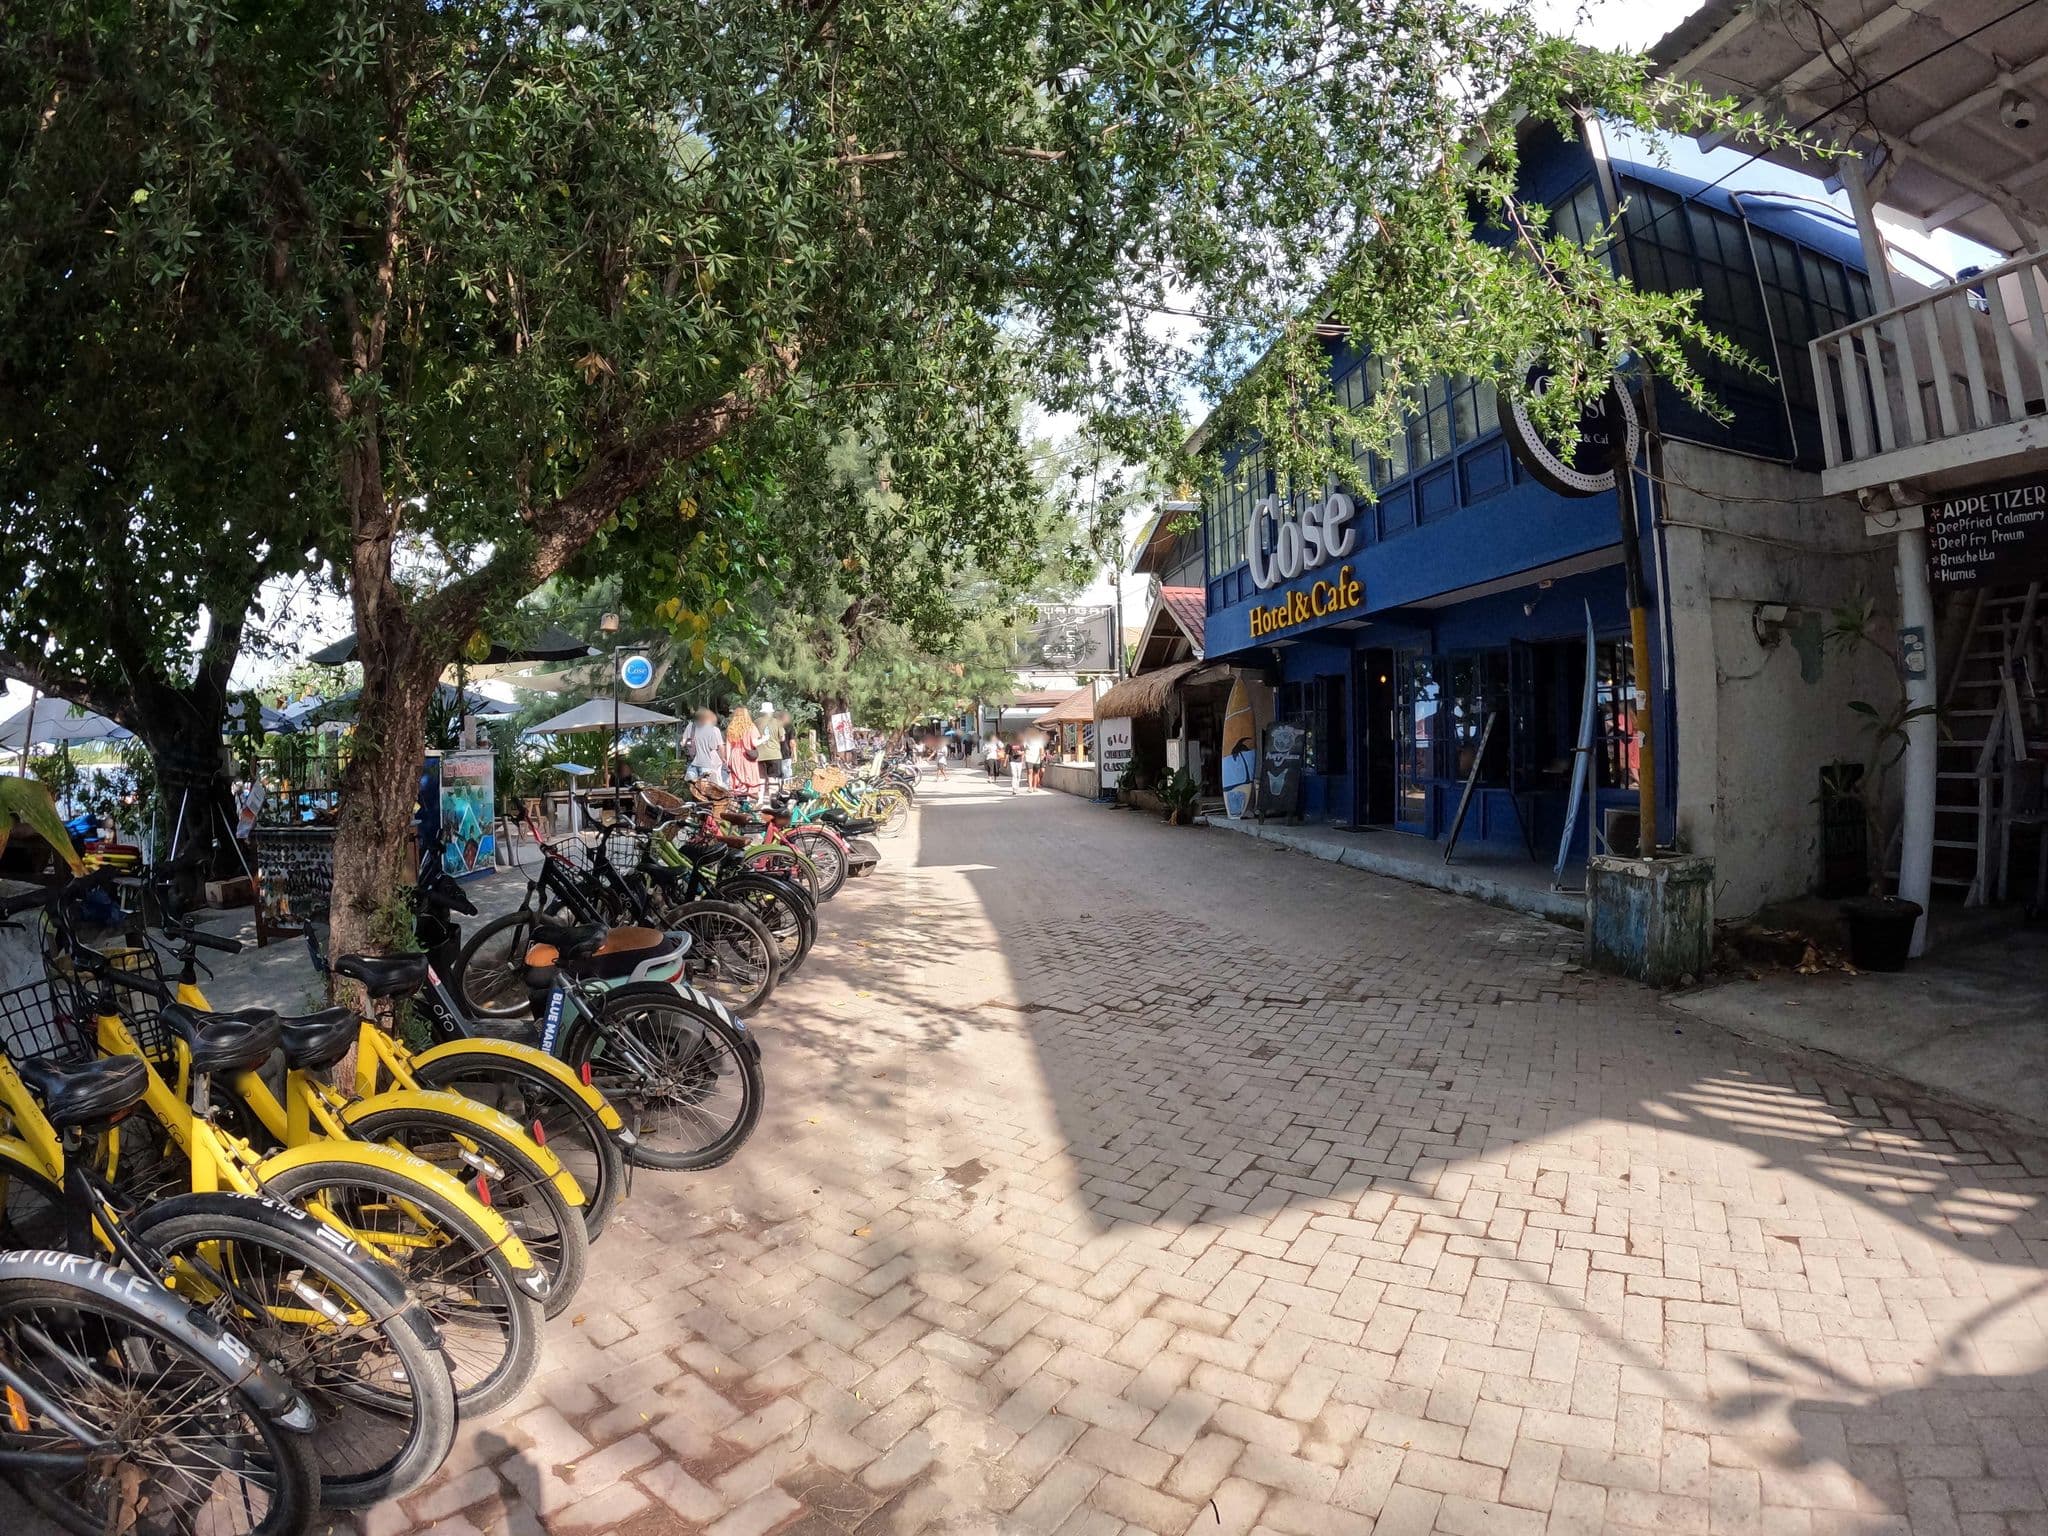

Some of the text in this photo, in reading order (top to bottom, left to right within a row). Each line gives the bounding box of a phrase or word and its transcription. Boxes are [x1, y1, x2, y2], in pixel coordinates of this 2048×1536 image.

[1943, 485, 2046, 519] APPETIZER
[1991, 529, 2025, 543] Prawn
[1940, 548, 1996, 567] Bruschetta
[1941, 569, 1977, 582] Humus
[547, 992, 564, 1022] BLUE
[217, 1331, 251, 1366] 18
